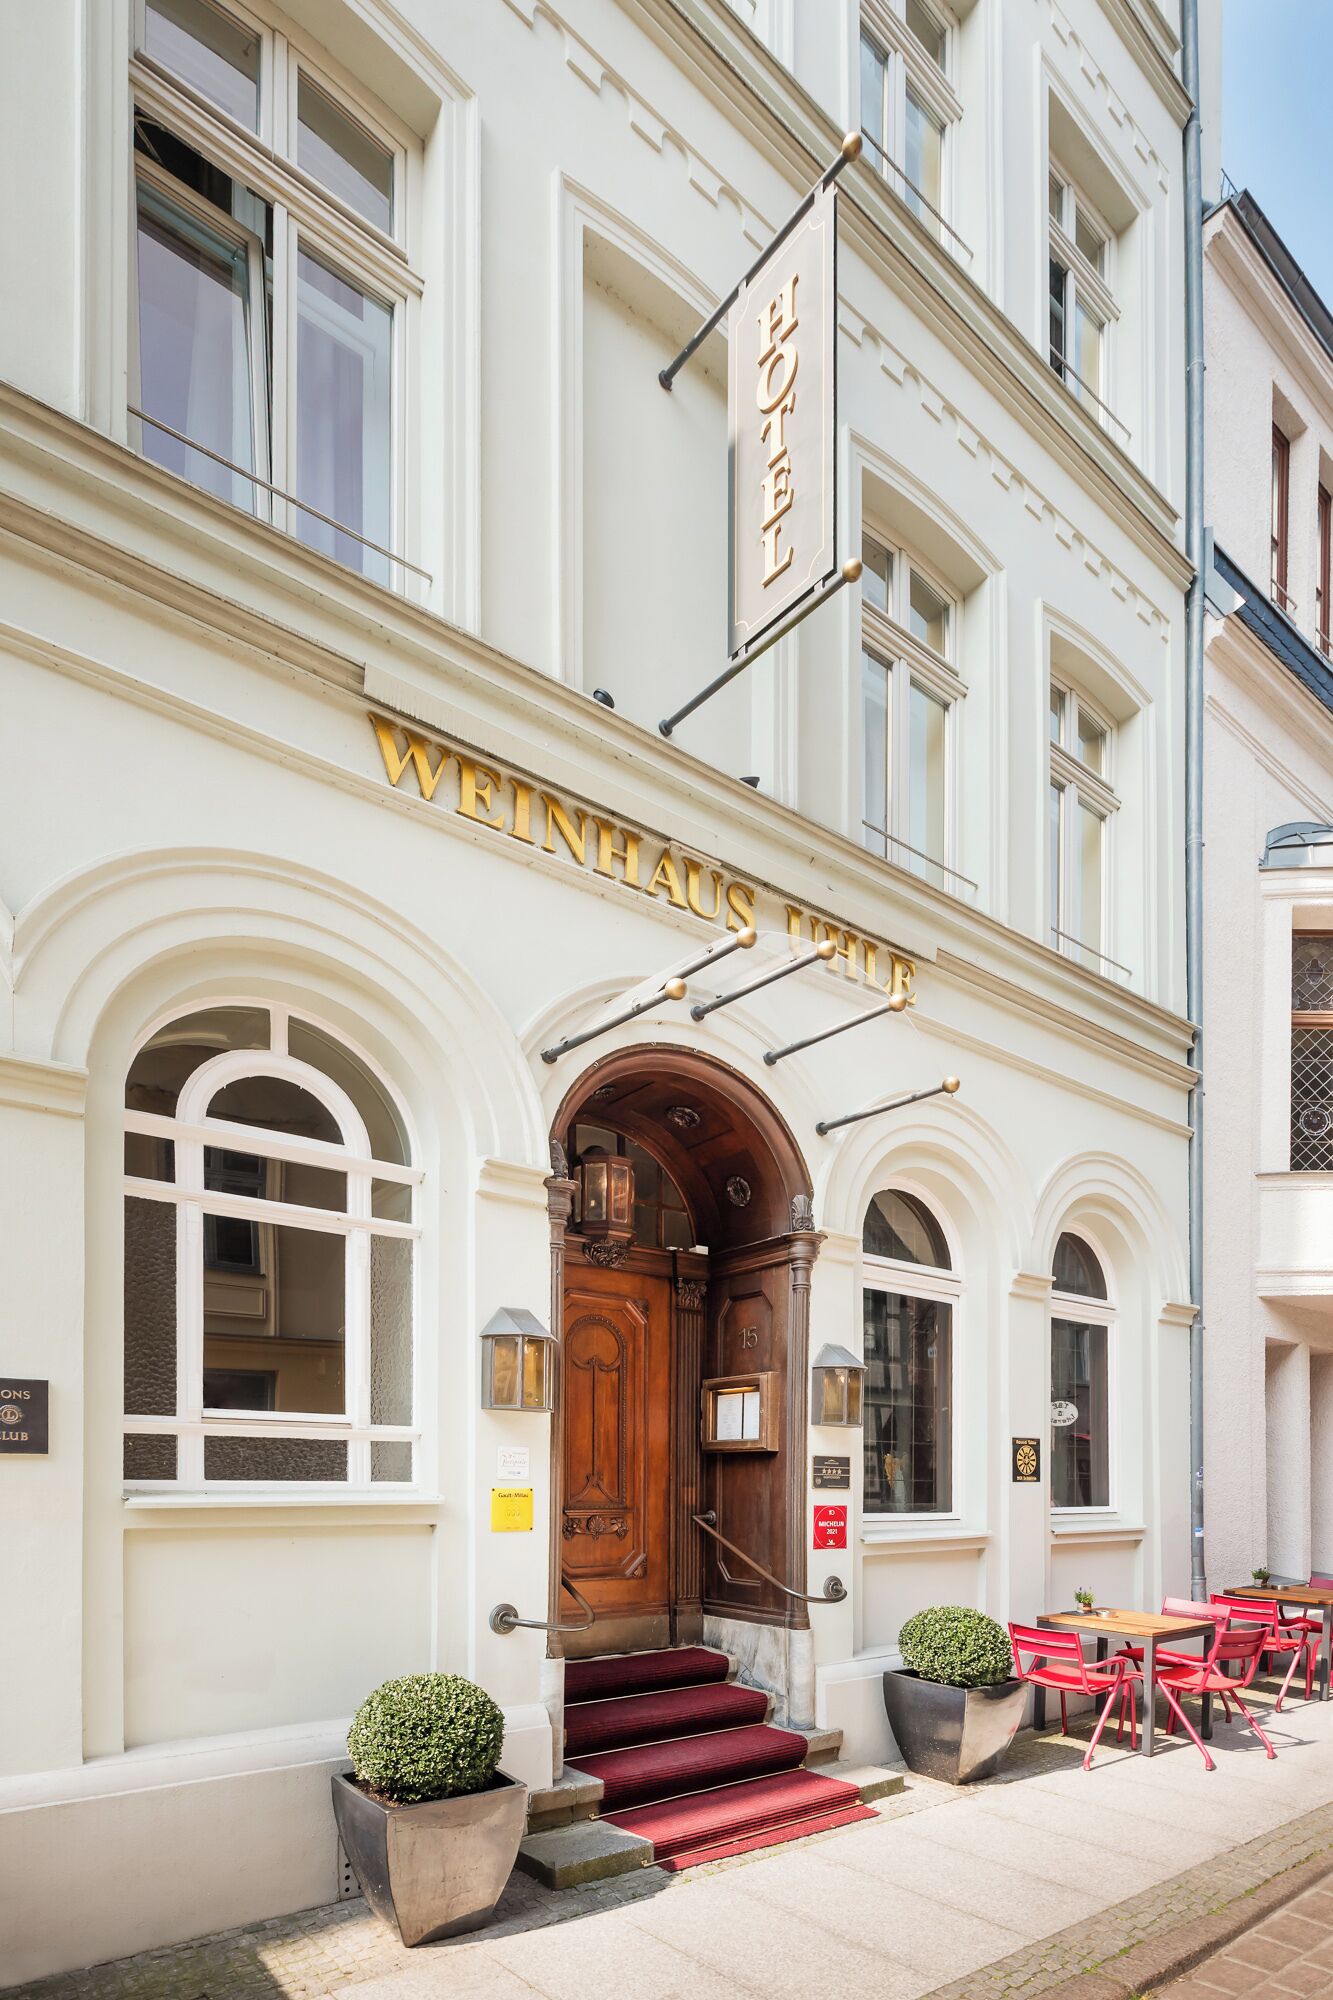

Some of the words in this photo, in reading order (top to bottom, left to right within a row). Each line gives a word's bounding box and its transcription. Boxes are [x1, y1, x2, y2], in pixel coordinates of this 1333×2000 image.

[756, 272, 799, 589] HOTEL
[368, 711, 756, 932] WEINHAUS
[785, 904, 917, 1005] UHLE
[738, 1326, 758, 1349] 15
